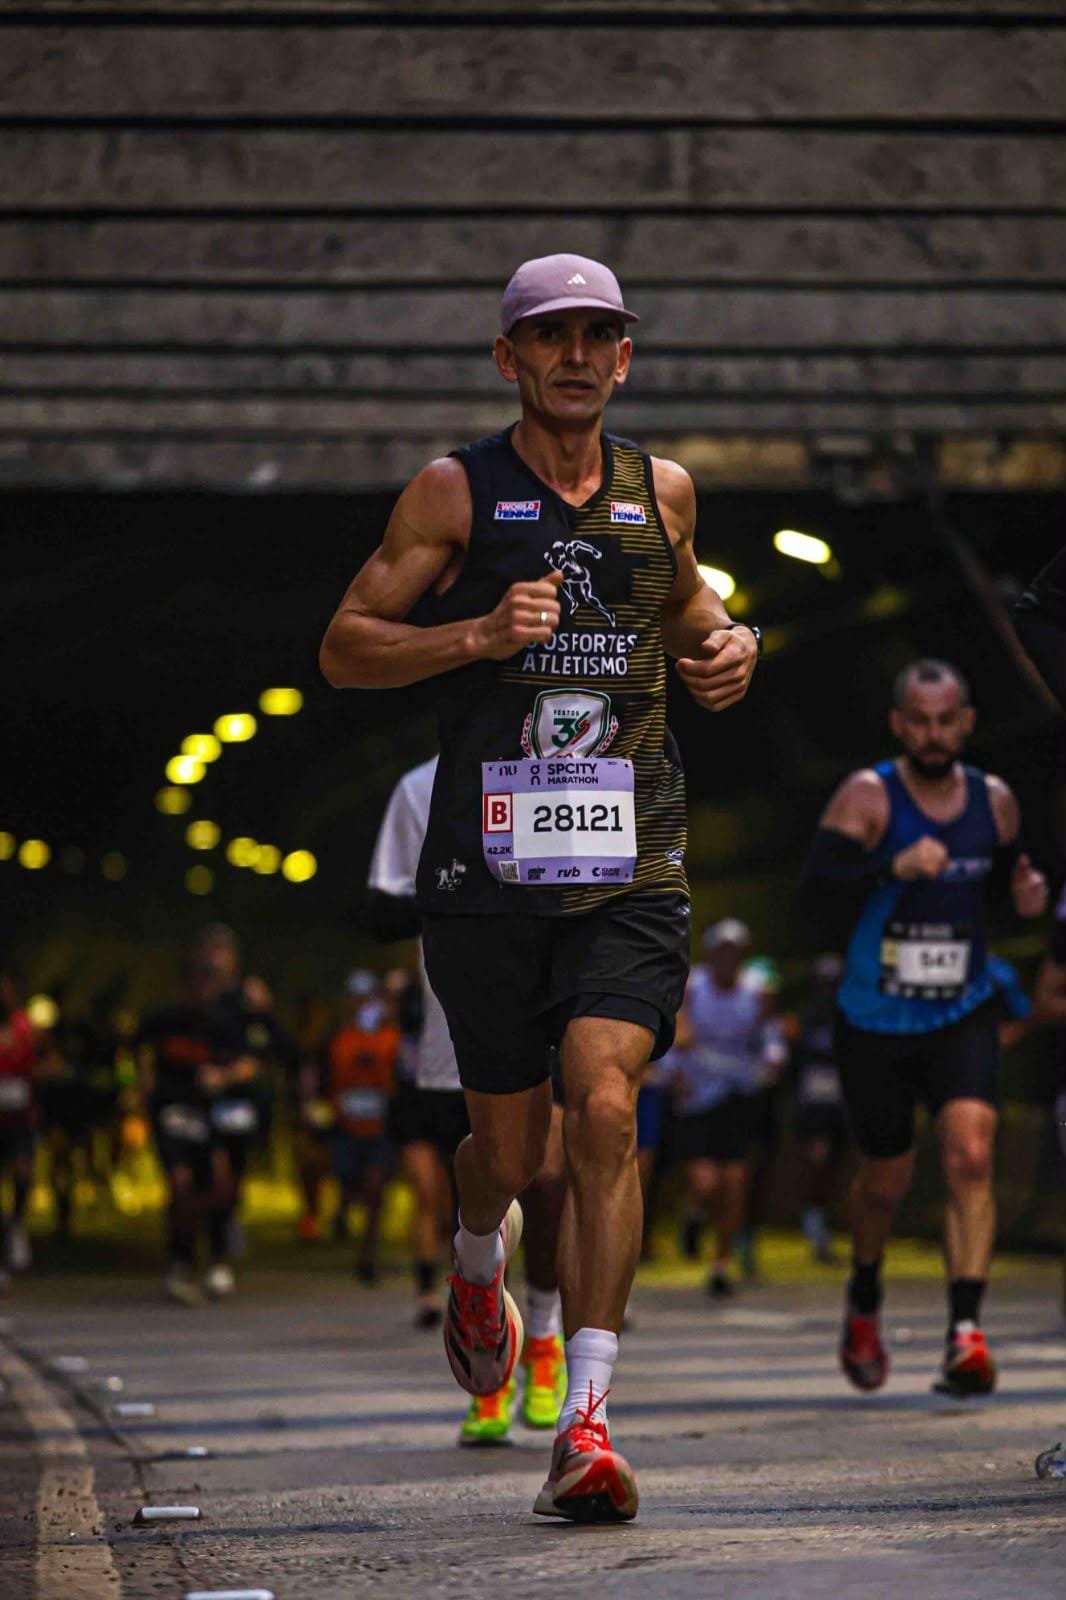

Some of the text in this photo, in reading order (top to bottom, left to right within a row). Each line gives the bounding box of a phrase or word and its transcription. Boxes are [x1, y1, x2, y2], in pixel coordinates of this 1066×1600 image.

[500, 502, 536, 510] WORLD
[497, 510, 538, 518] TENNIS
[612, 512, 645, 522] TENNIS
[522, 653, 628, 675] ATLETISMO
[547, 763, 598, 775] SPCITY
[547, 776, 599, 785] MARATHON
[491, 801, 507, 825] B
[533, 804, 623, 832] 28121
[487, 846, 512, 855] 42.2K
